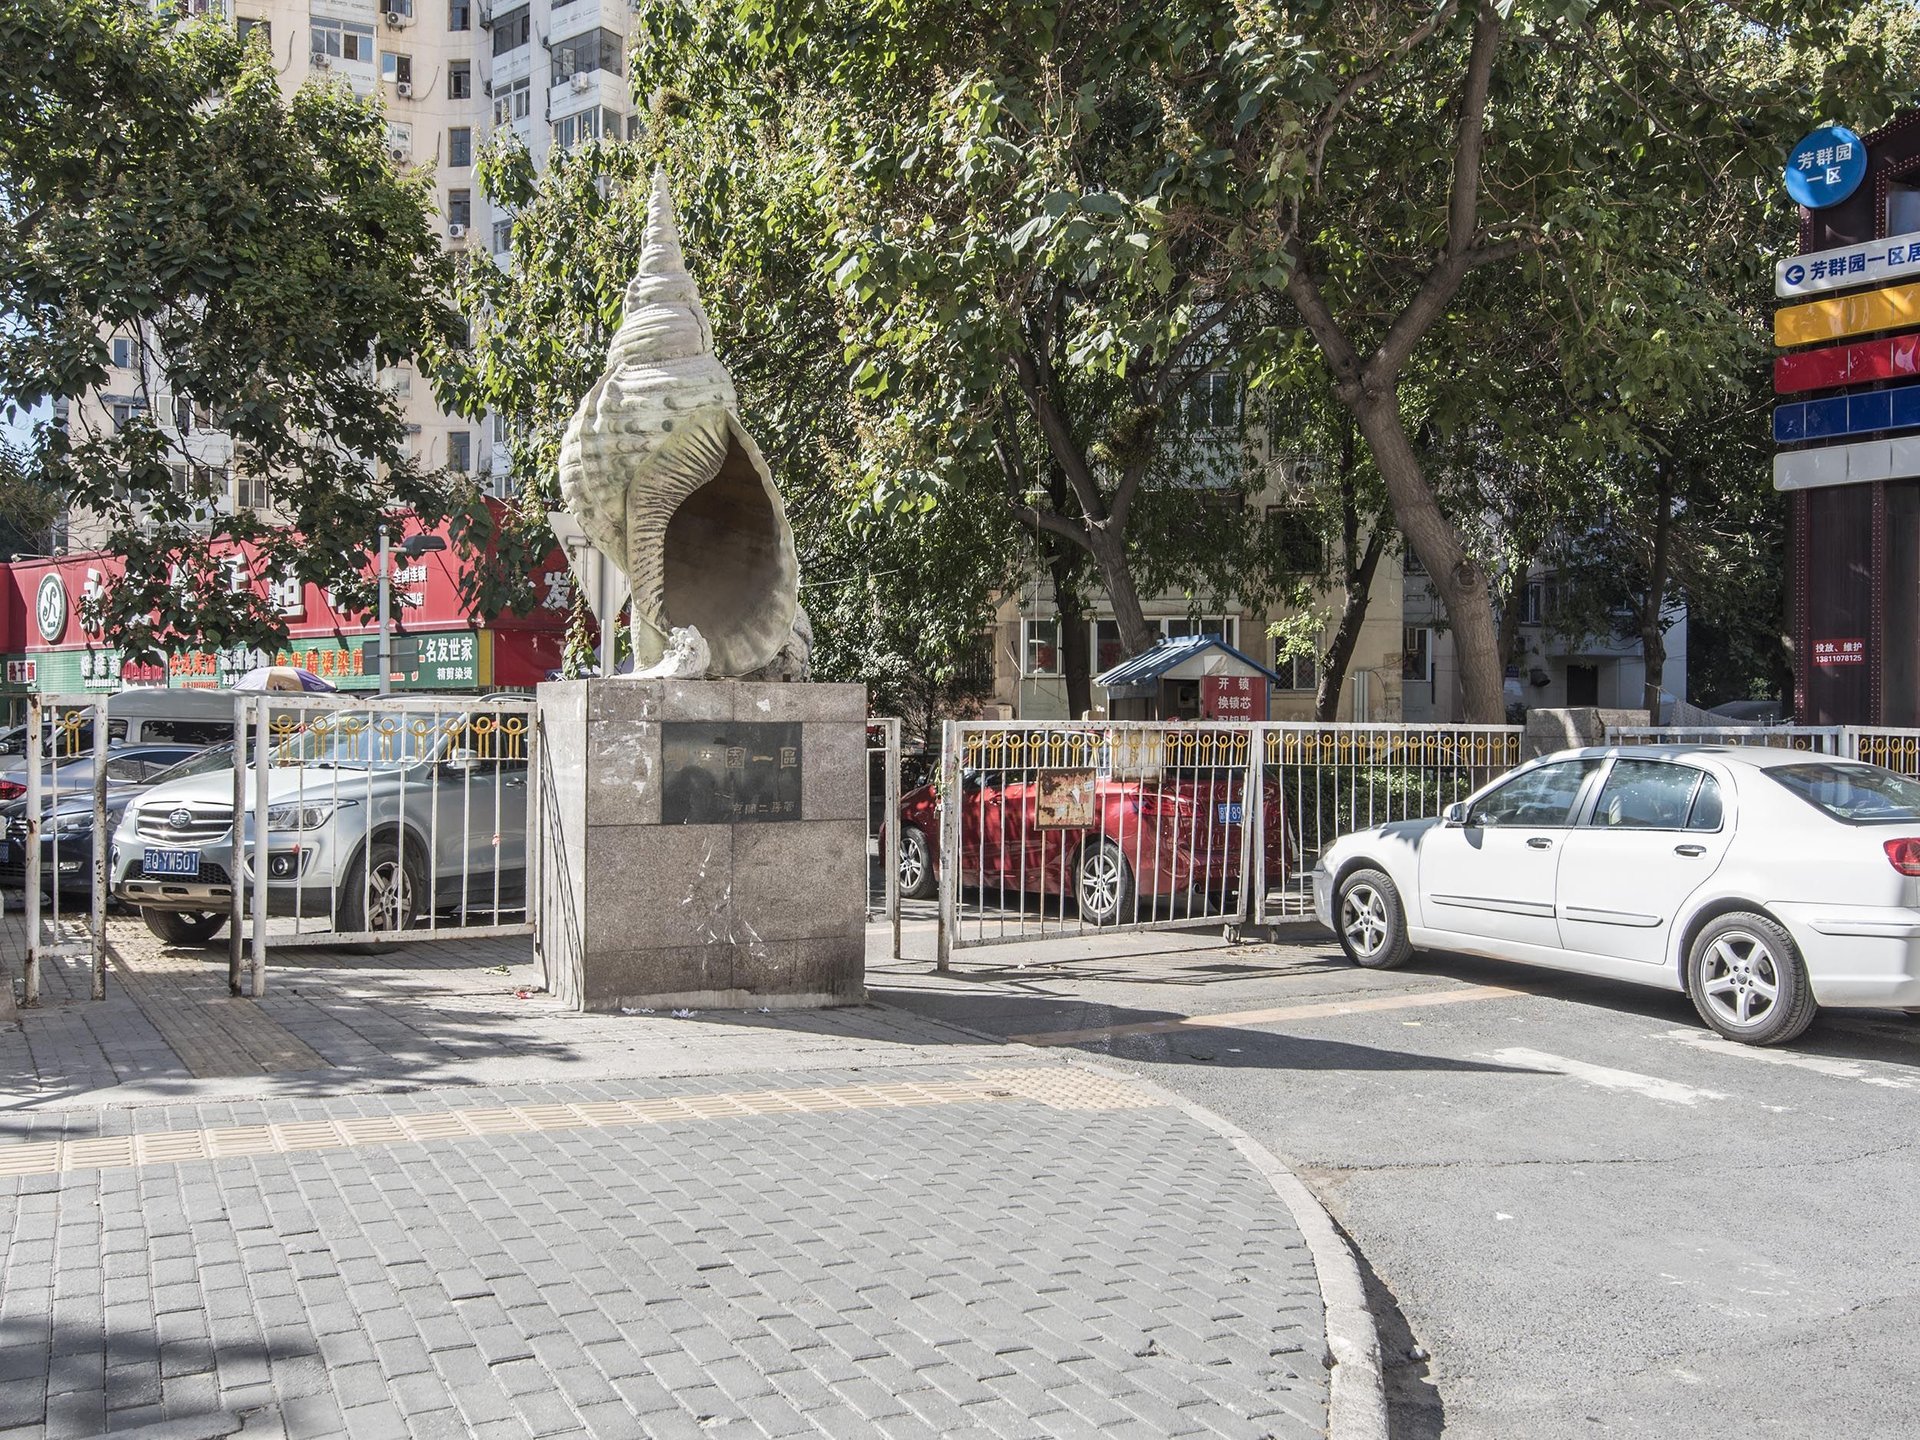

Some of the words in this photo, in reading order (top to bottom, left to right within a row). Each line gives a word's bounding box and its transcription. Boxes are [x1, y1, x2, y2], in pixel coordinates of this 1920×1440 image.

[1798, 143, 1852, 170] 芳群园
[1806, 166, 1842, 185] 一区
[425, 637, 473, 663] 名发世家
[1218, 695, 1251, 709] 换锁芯
